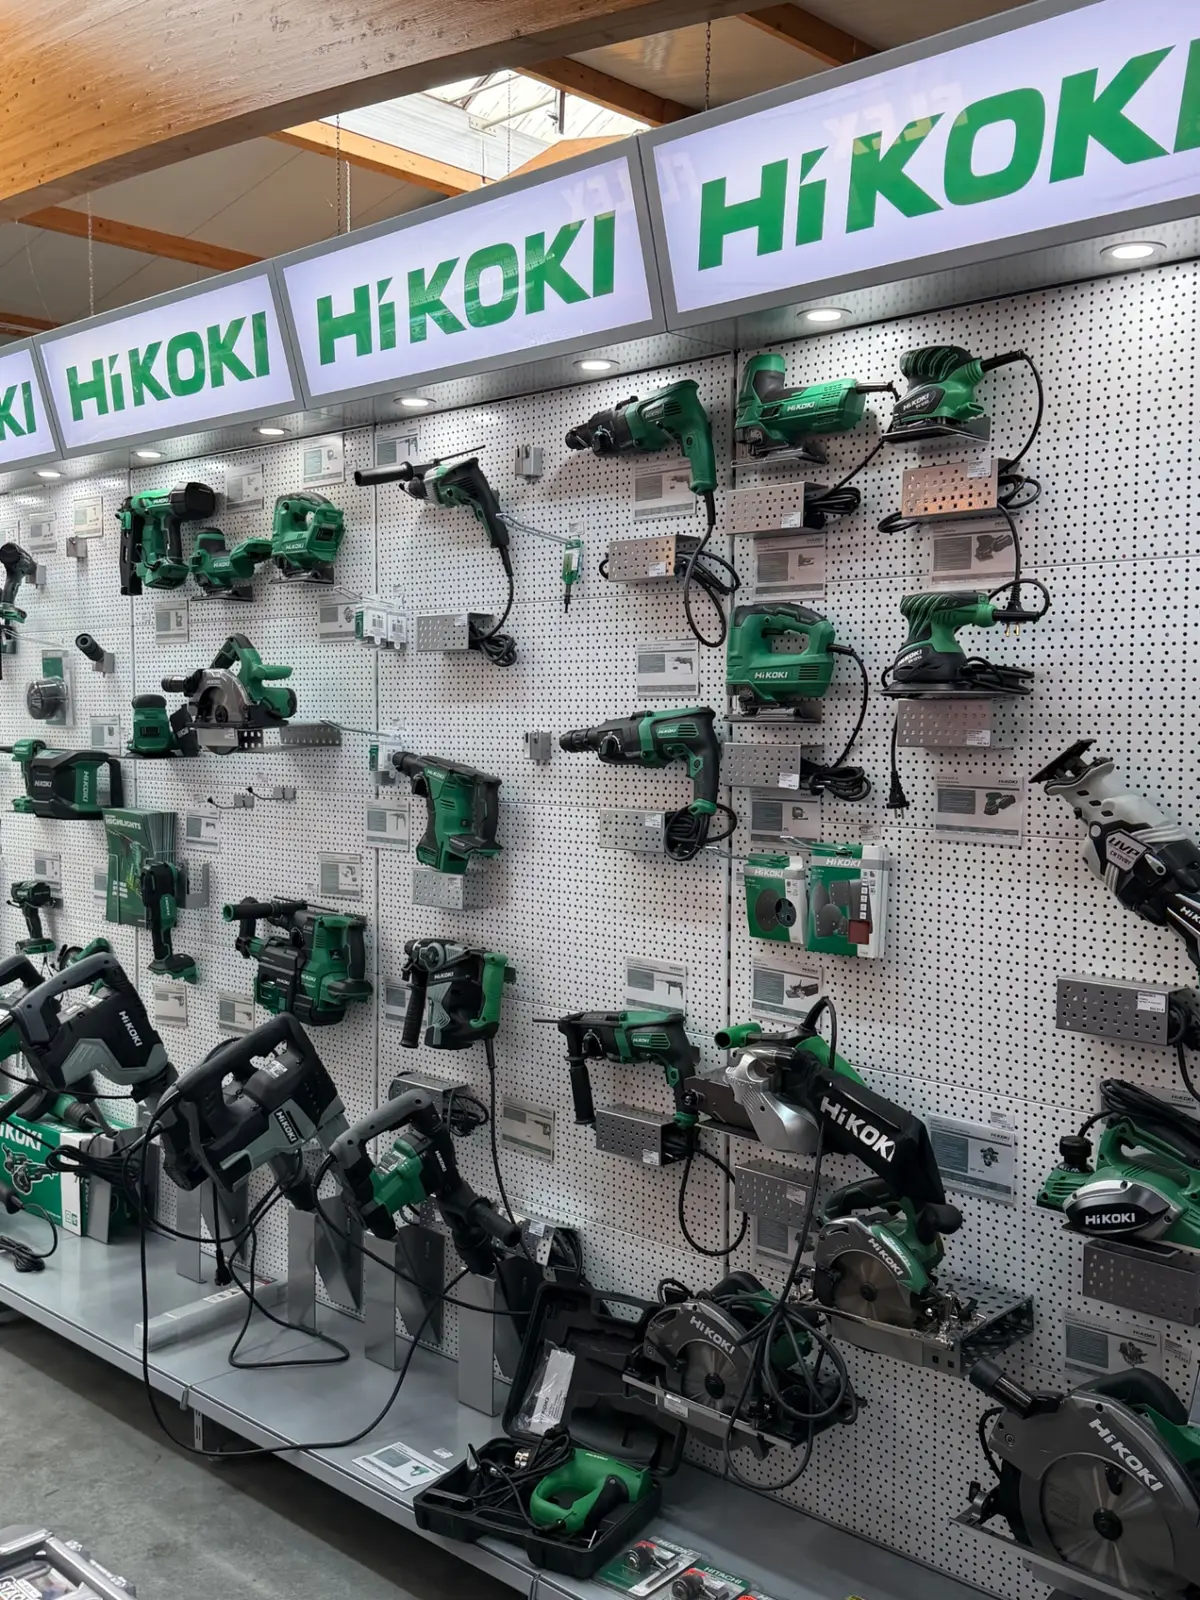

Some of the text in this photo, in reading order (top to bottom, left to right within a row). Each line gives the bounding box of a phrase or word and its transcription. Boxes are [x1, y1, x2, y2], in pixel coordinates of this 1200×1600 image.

[317, 210, 616, 365] HiKOKI
[66, 311, 270, 421] HiKOKI
[787, 401, 816, 412] HiKOKI
[903, 393, 930, 411] HiKOKI
[755, 671, 788, 679] HiKOKI
[105, 818, 142, 830] HIGHLIGHTS
[1108, 837, 1140, 856] UVP
[826, 858, 862, 867] HiKOKI
[754, 868, 784, 878] HiKOKI
[434, 971, 454, 979] HiKOKI
[119, 1010, 144, 1047] HiKOKI
[275, 1110, 297, 1143] HiKOKI
[820, 1096, 895, 1163] HiKOKI
[435, 1151, 447, 1172] HiKOKI
[1085, 1212, 1136, 1225] HiKOKI
[868, 1237, 904, 1276] HiKOKI
[690, 1315, 735, 1354] HiKOKI
[1088, 1418, 1164, 1492] HiKOKI
[657, 1539, 694, 1556] HiKOKI
[703, 1566, 743, 1585] HITACHI
